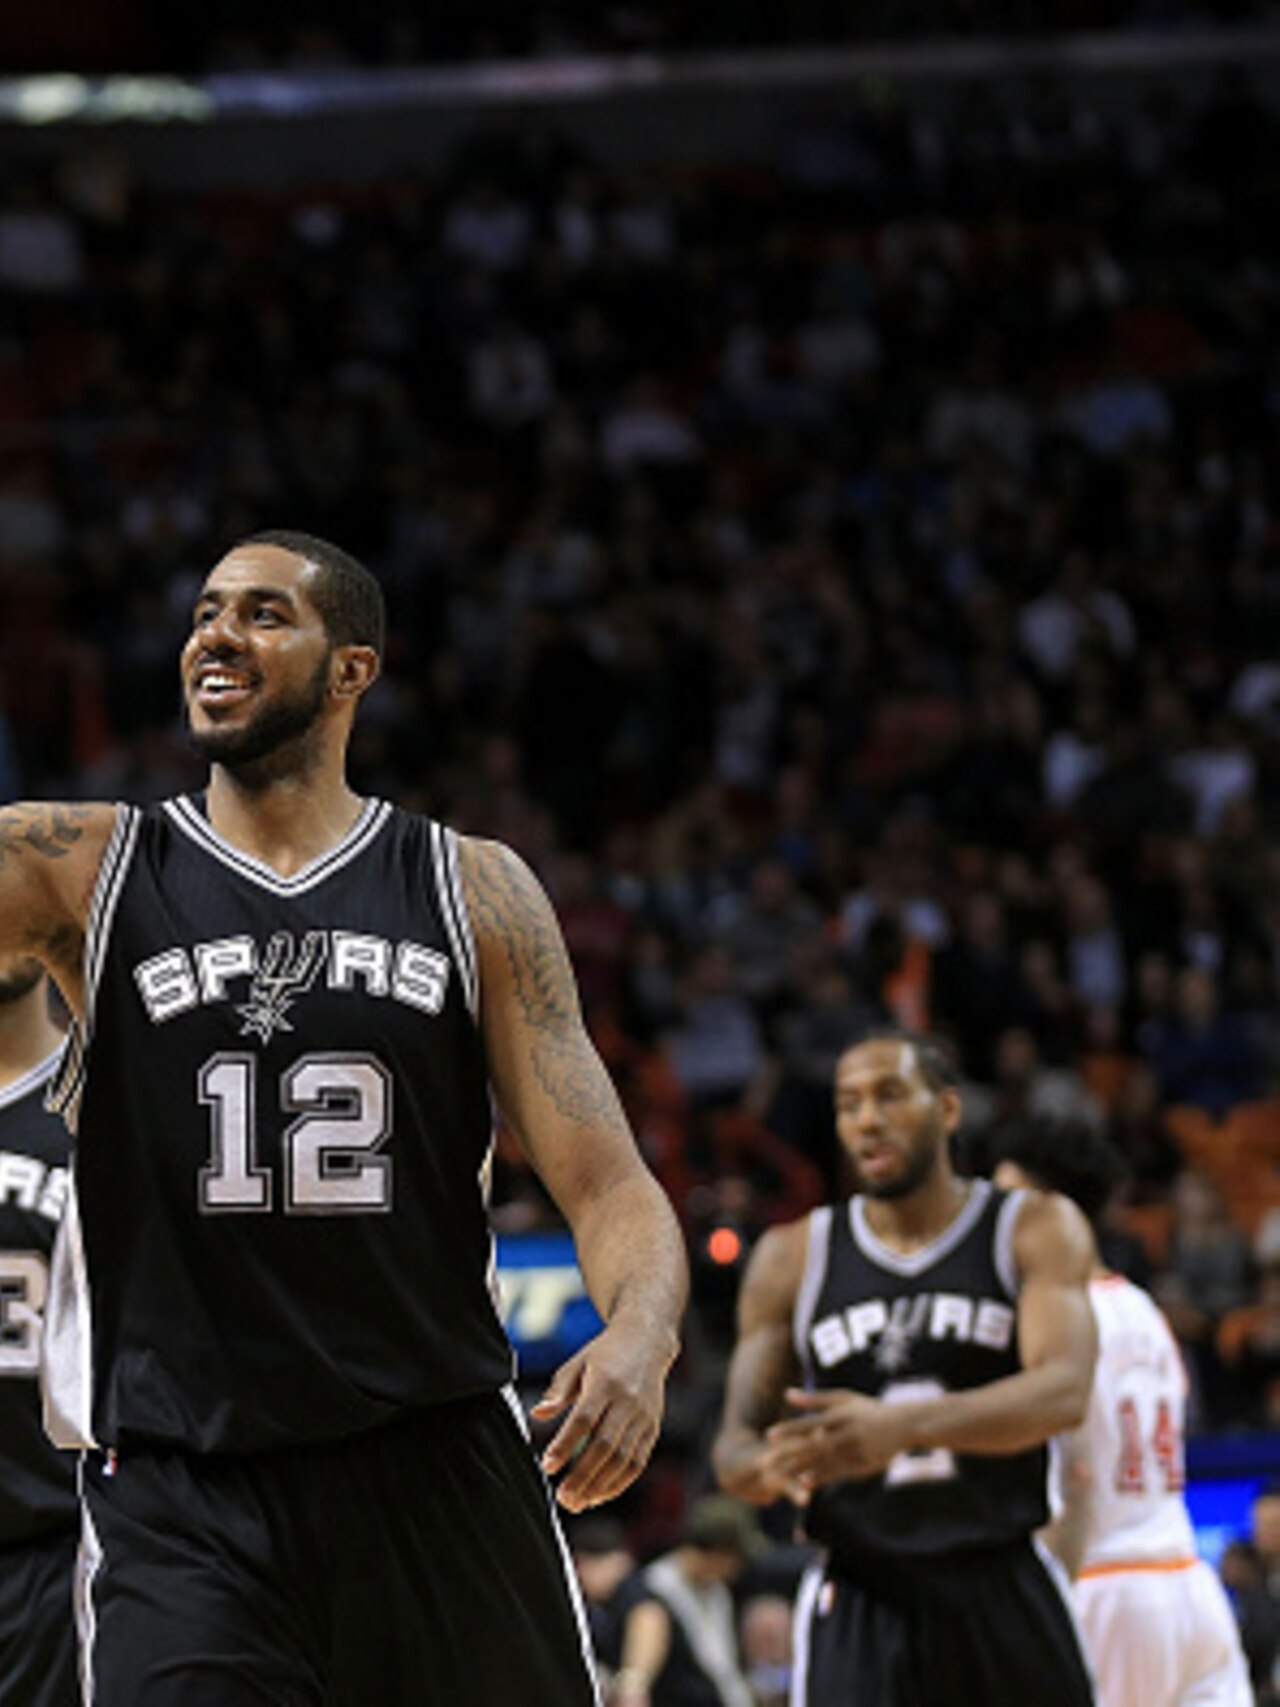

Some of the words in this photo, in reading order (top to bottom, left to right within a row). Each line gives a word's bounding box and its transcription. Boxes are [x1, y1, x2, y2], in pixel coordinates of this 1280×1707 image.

[133, 930, 451, 1046] SPURS
[197, 1050, 393, 1215] 12
[812, 1294, 1014, 1370] SPURS
